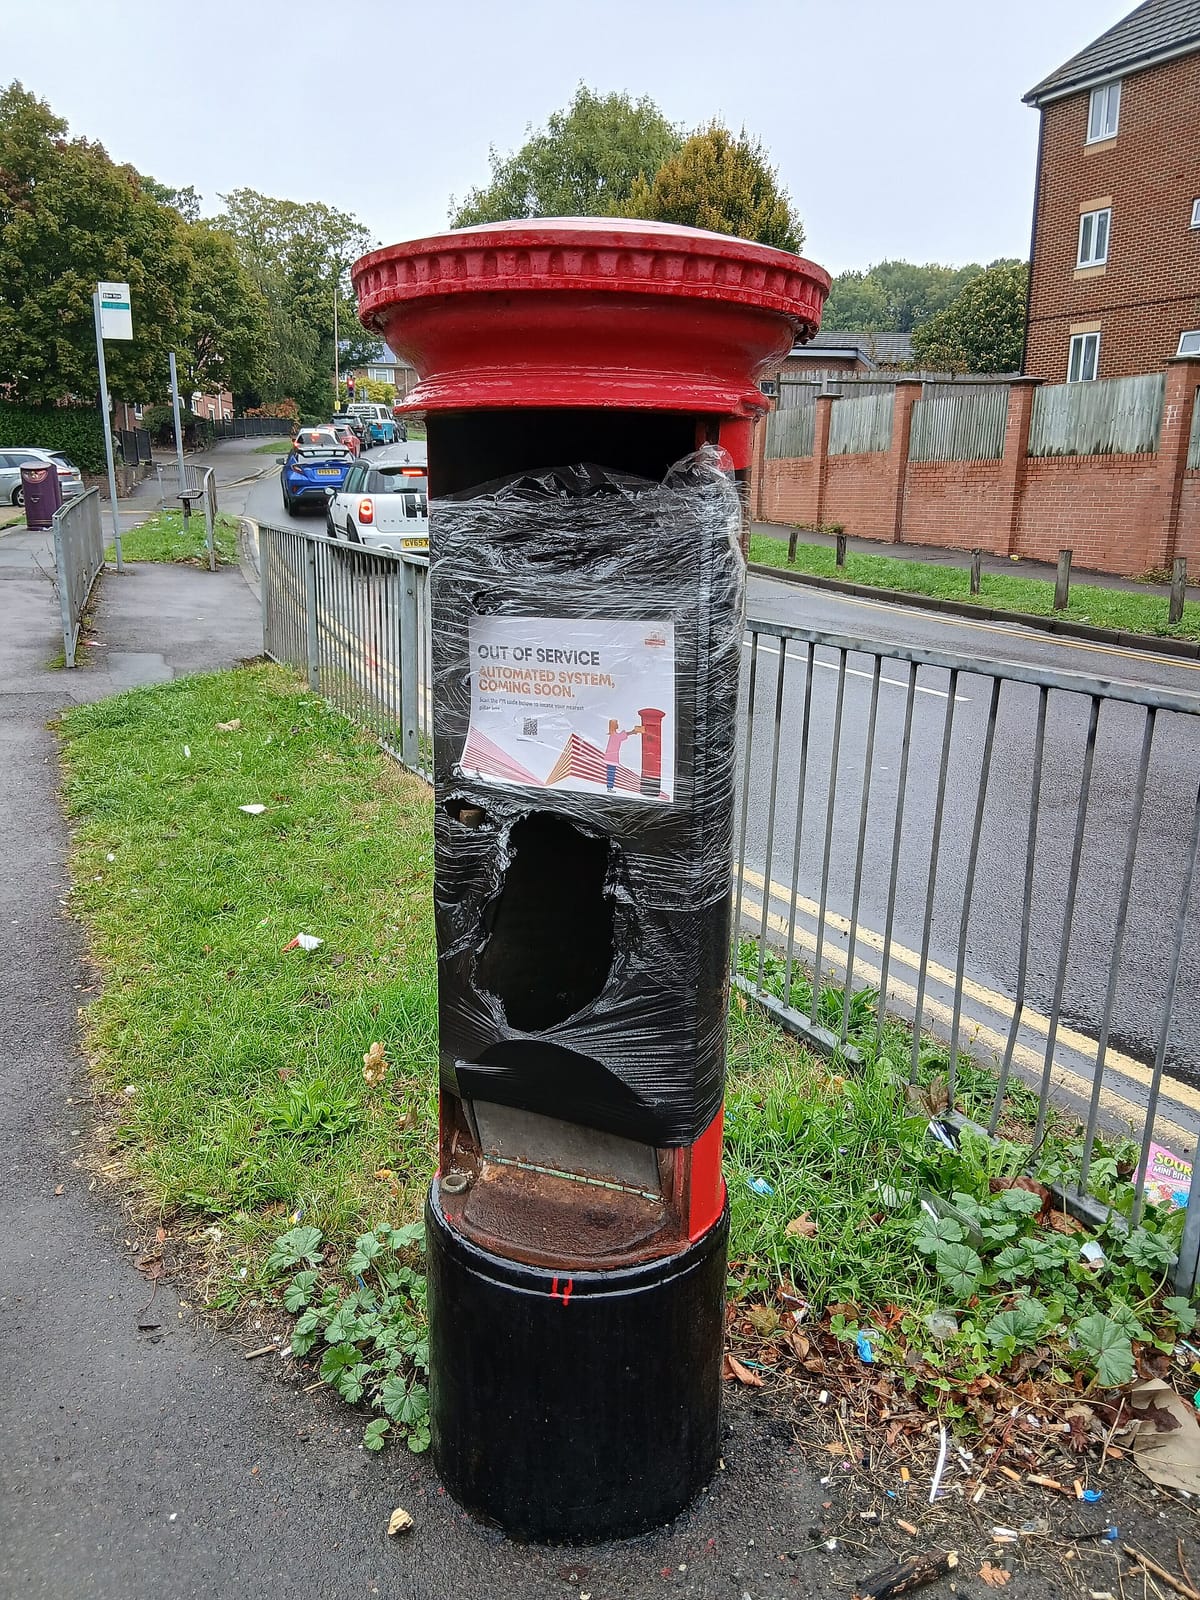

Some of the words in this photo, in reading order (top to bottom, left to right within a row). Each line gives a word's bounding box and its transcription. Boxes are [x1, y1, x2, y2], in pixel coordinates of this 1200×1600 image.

[405, 539, 423, 547] GV65
[478, 644, 508, 660] OUT
[513, 646, 533, 661] OF
[536, 647, 600, 666] SERVICE
[479, 666, 556, 682] AUTOMATED
[558, 671, 616, 688] SYSTEM,
[479, 679, 531, 695] COMING
[534, 682, 576, 698] SOON.
[1153, 1151, 1192, 1176] SOUR
[1153, 1165, 1171, 1177] MINI
